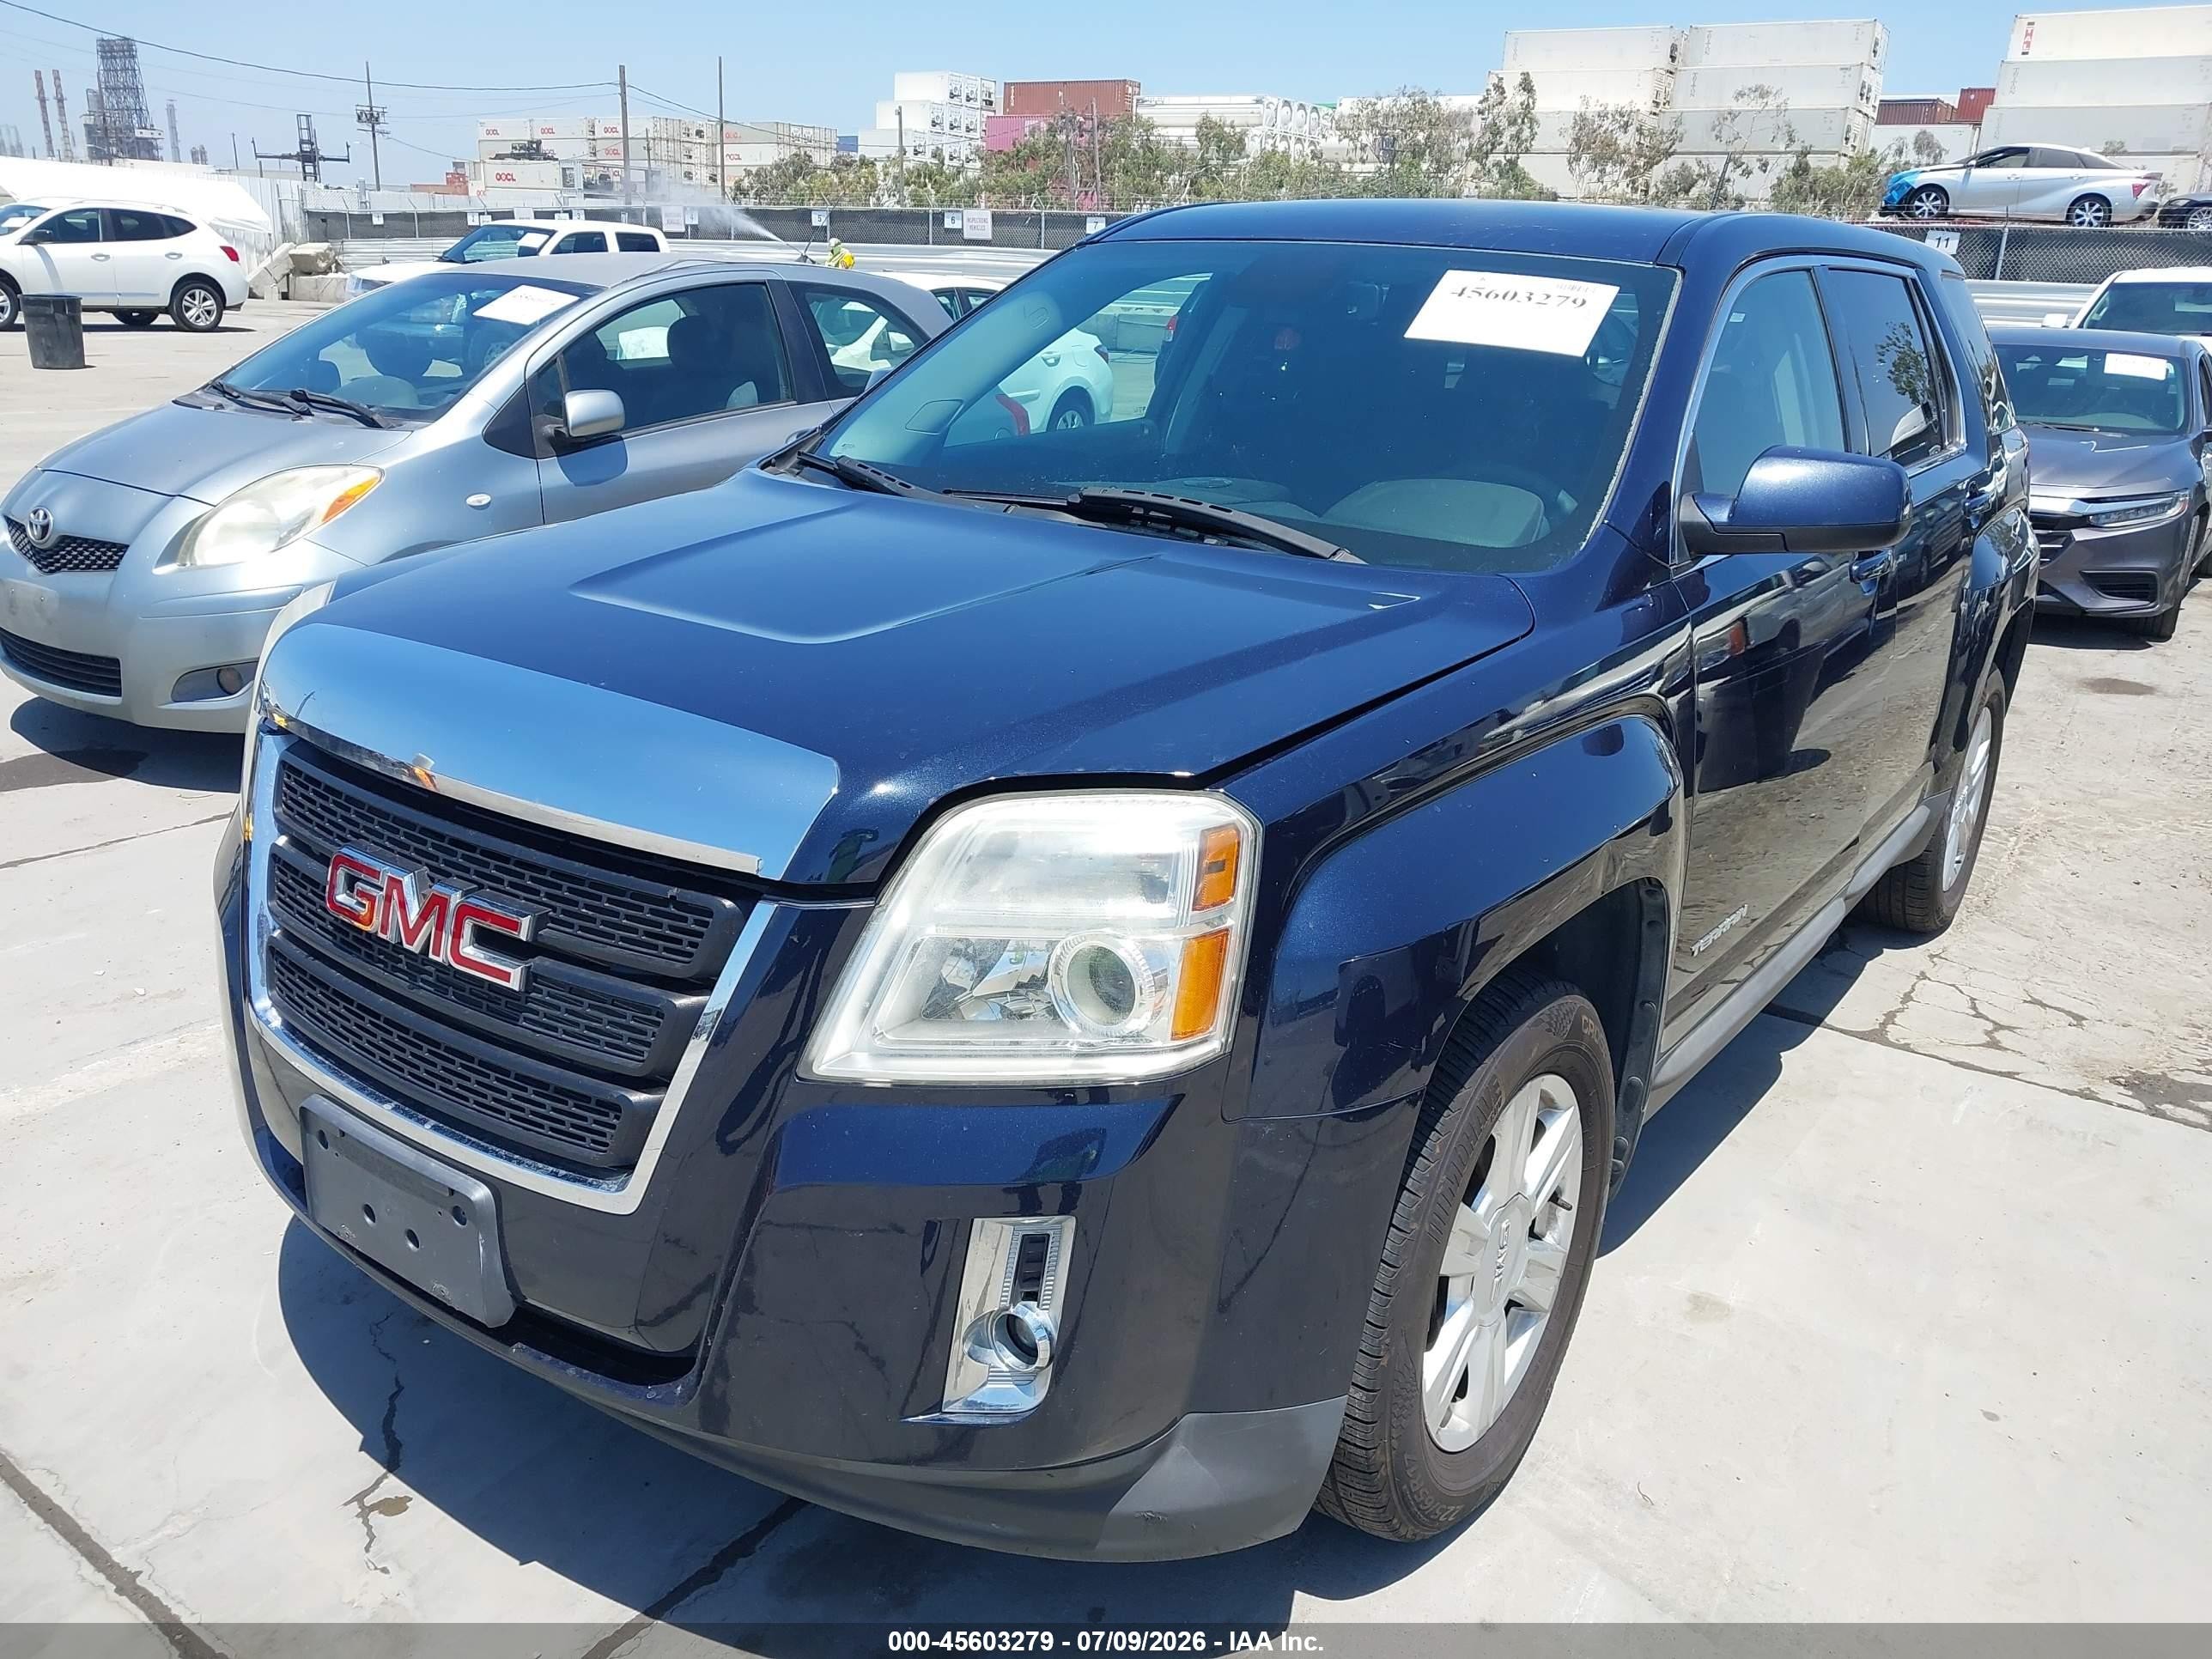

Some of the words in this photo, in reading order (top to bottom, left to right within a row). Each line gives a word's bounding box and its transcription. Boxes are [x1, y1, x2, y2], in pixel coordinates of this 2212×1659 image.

[495, 173, 517, 182] OOCL
[817, 214, 823, 222] 5
[951, 216, 956, 225] 6
[1093, 221, 1099, 230] 7
[1936, 236, 1950, 248] 11
[1450, 286, 1588, 308] 45603279
[325, 845, 544, 992] GMC
